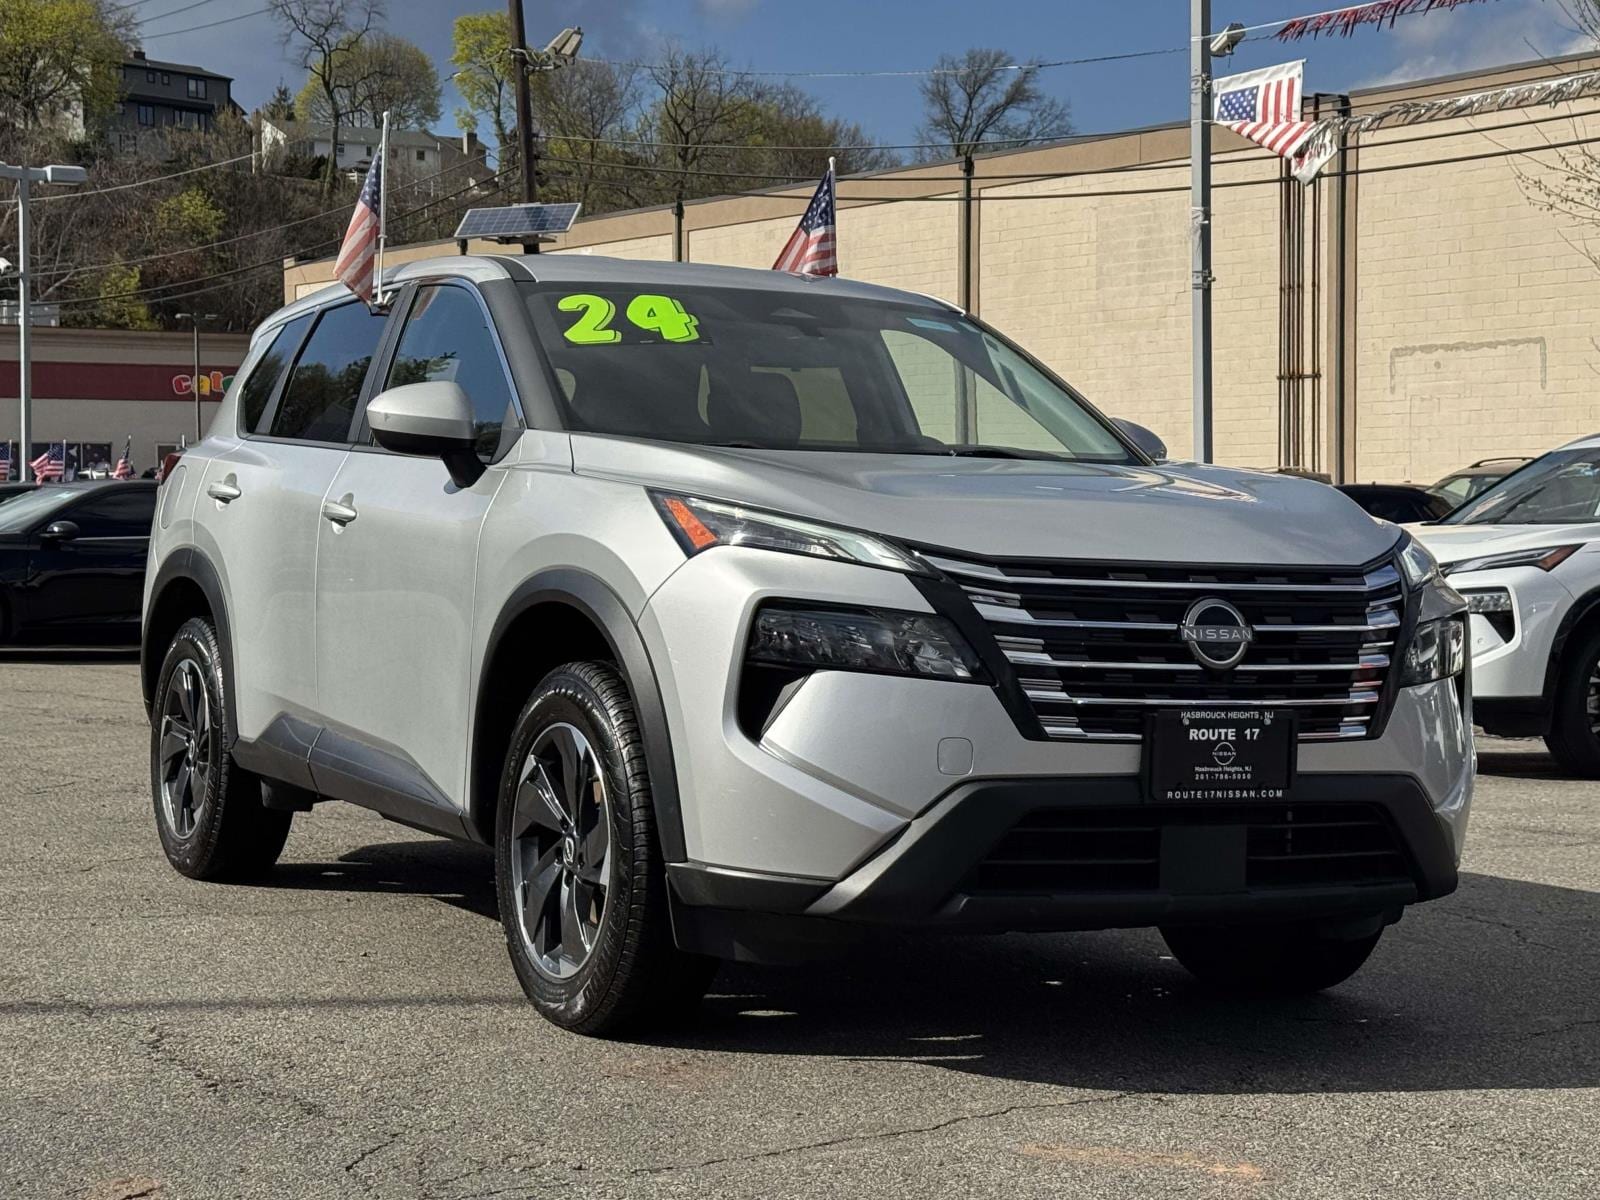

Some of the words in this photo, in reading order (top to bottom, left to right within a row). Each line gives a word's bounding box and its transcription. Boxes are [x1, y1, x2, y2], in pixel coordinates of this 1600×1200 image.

[557, 294, 700, 344] 24
[1183, 628, 1252, 640] NISSAN
[1181, 711, 1226, 719] HASBROUCK
[1264, 711, 1274, 719] NJ
[1189, 728, 1236, 740] ROUTE
[1244, 728, 1260, 740] 17
[1167, 790, 1283, 799] ROUTE17NISSAN.COM
